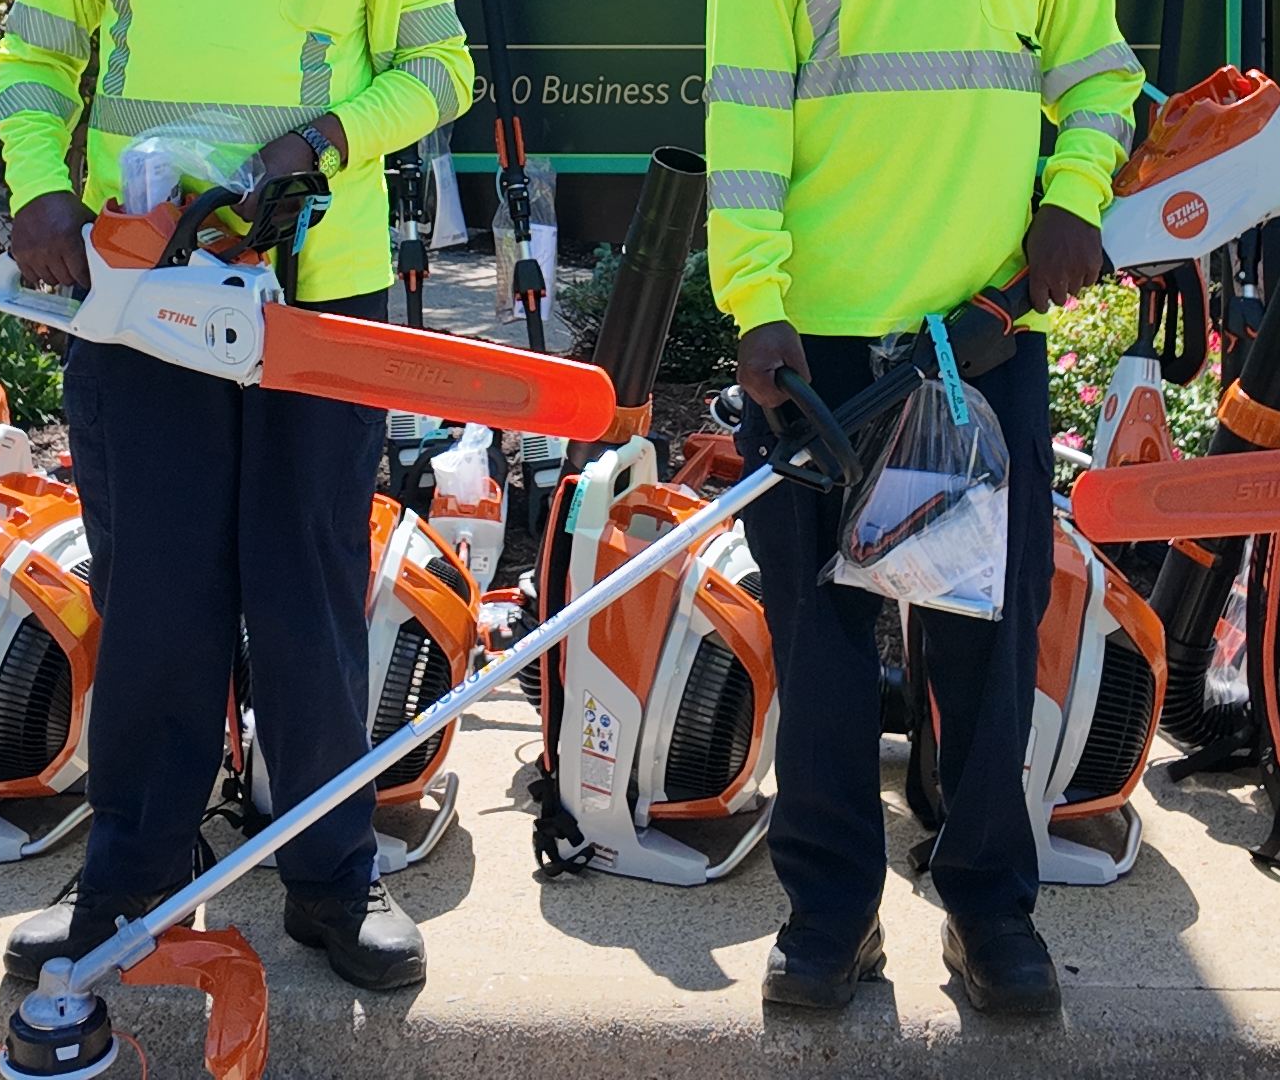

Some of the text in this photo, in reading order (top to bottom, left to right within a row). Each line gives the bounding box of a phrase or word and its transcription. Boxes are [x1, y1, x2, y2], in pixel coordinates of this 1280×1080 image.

[542, 75, 669, 104] Business
[1166, 199, 1204, 227] STIHL
[157, 308, 197, 327] STIHL
[384, 358, 453, 388] STIHL
